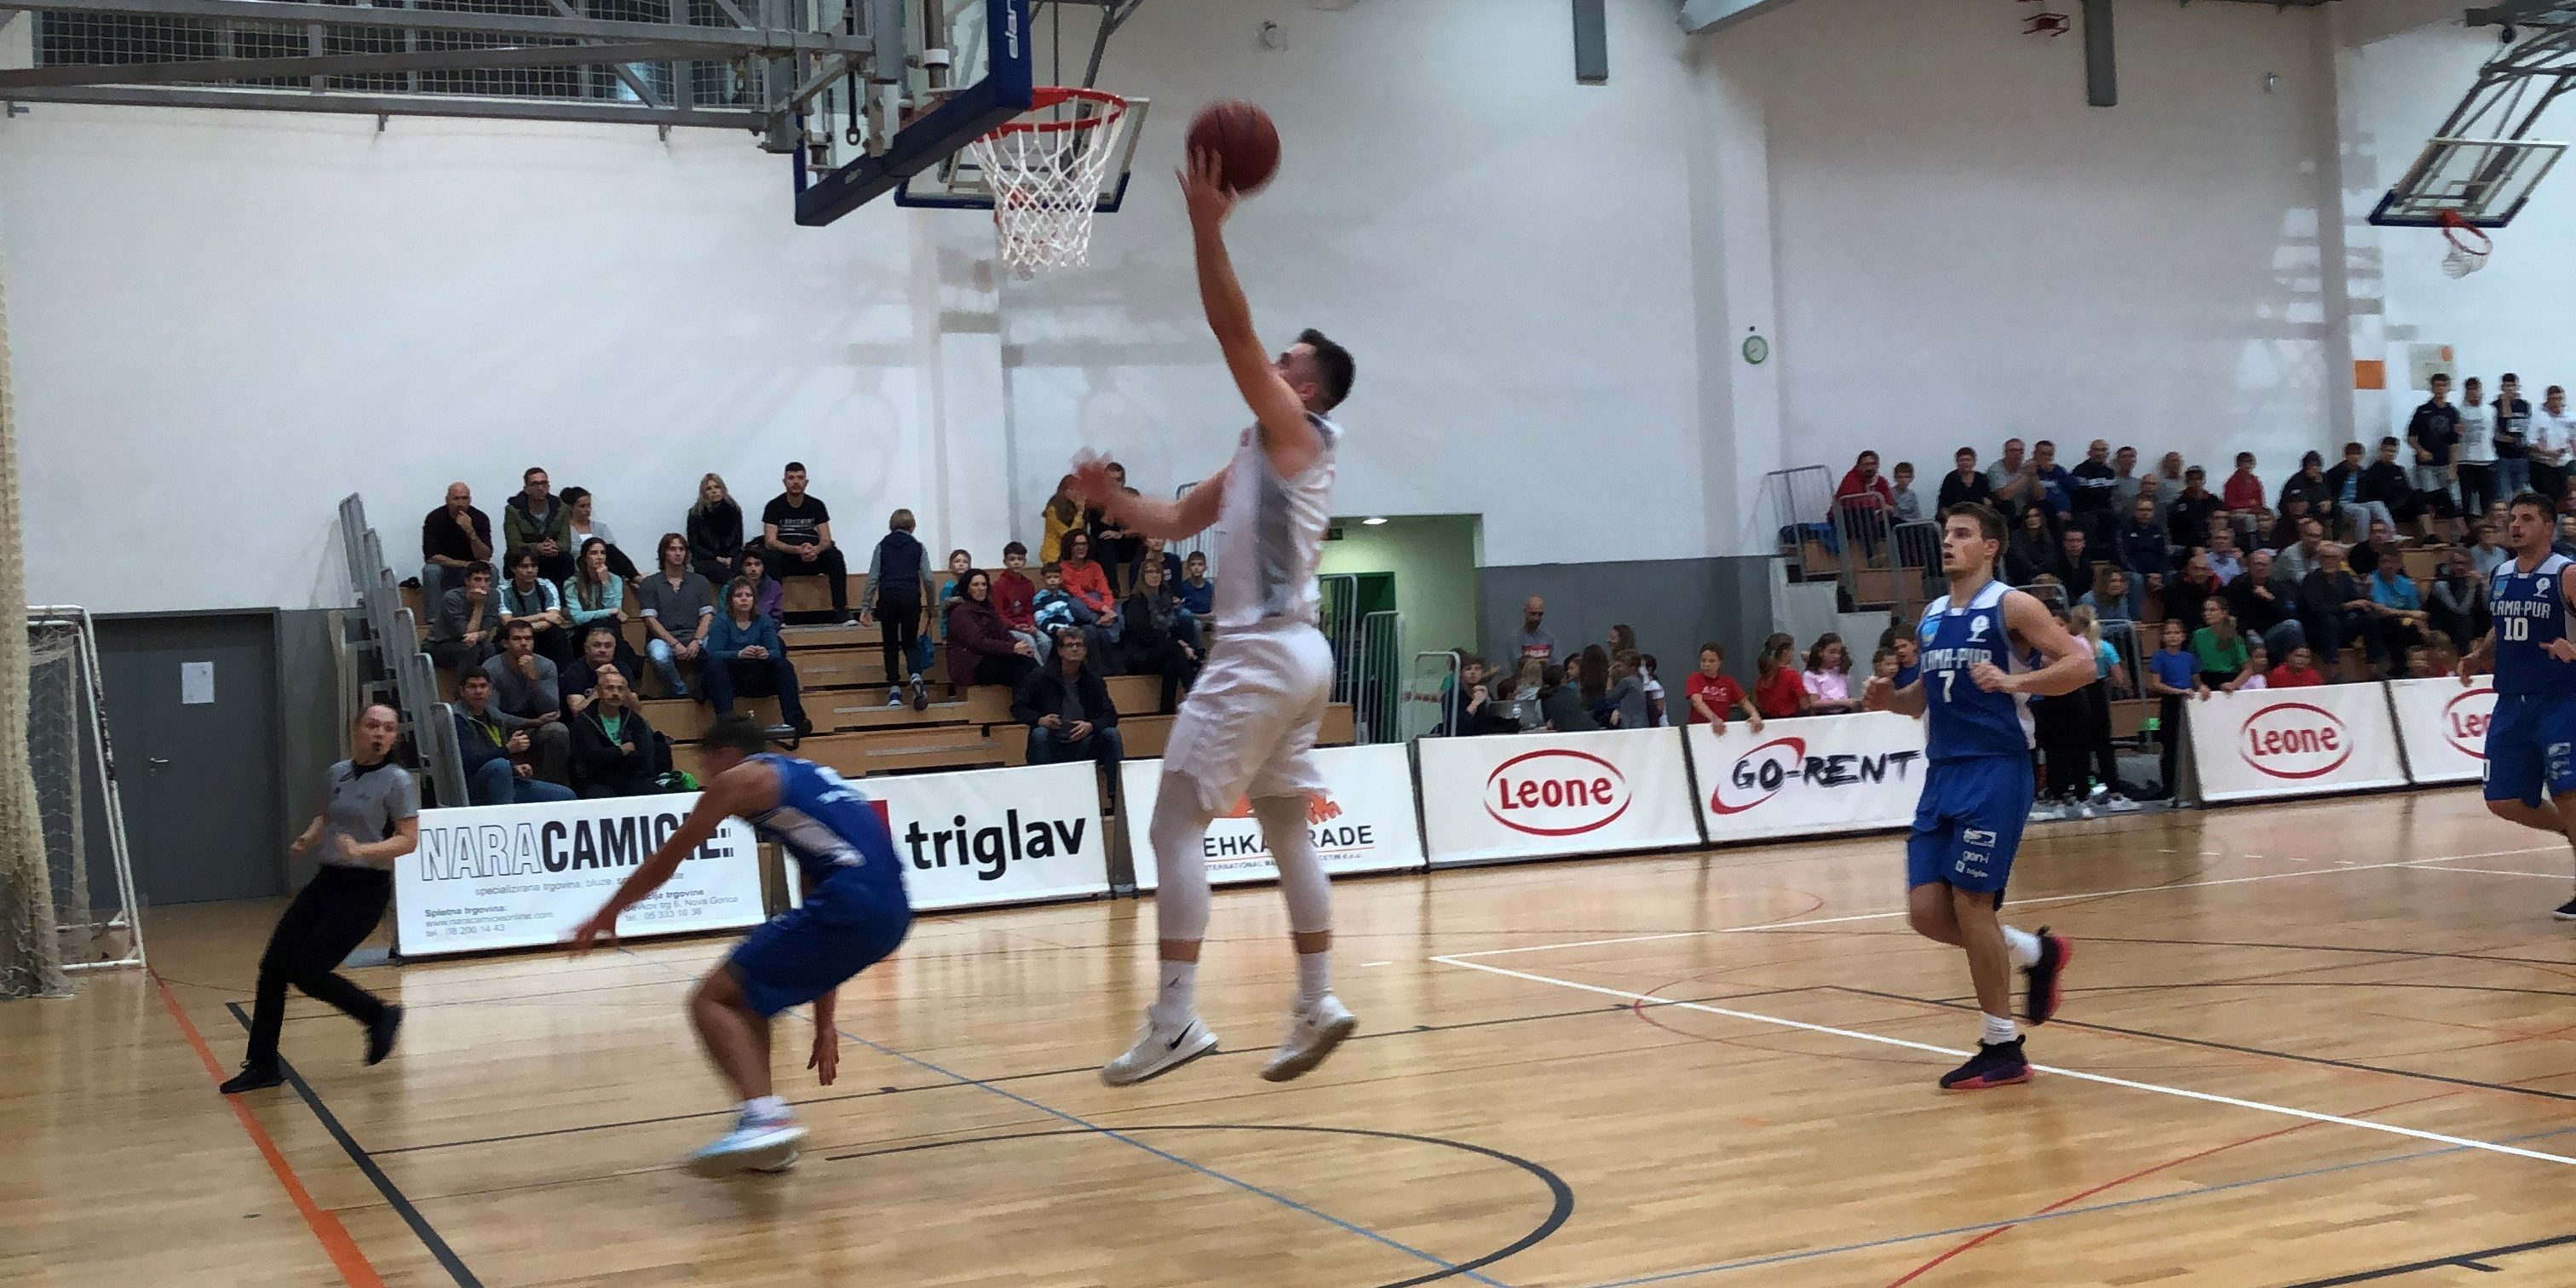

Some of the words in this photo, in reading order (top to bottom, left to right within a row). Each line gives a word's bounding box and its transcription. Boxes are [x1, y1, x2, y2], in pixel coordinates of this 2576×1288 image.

[2504, 617, 2528, 641] 10
[1938, 670, 1955, 703] 7
[2250, 727, 2340, 756] Leone
[1732, 749, 1922, 792] GO-RENT
[1499, 777, 1614, 810] Leone
[905, 808, 1086, 881] triglav
[1203, 833, 1269, 858] EHK
[1306, 824, 1375, 849] RADE
